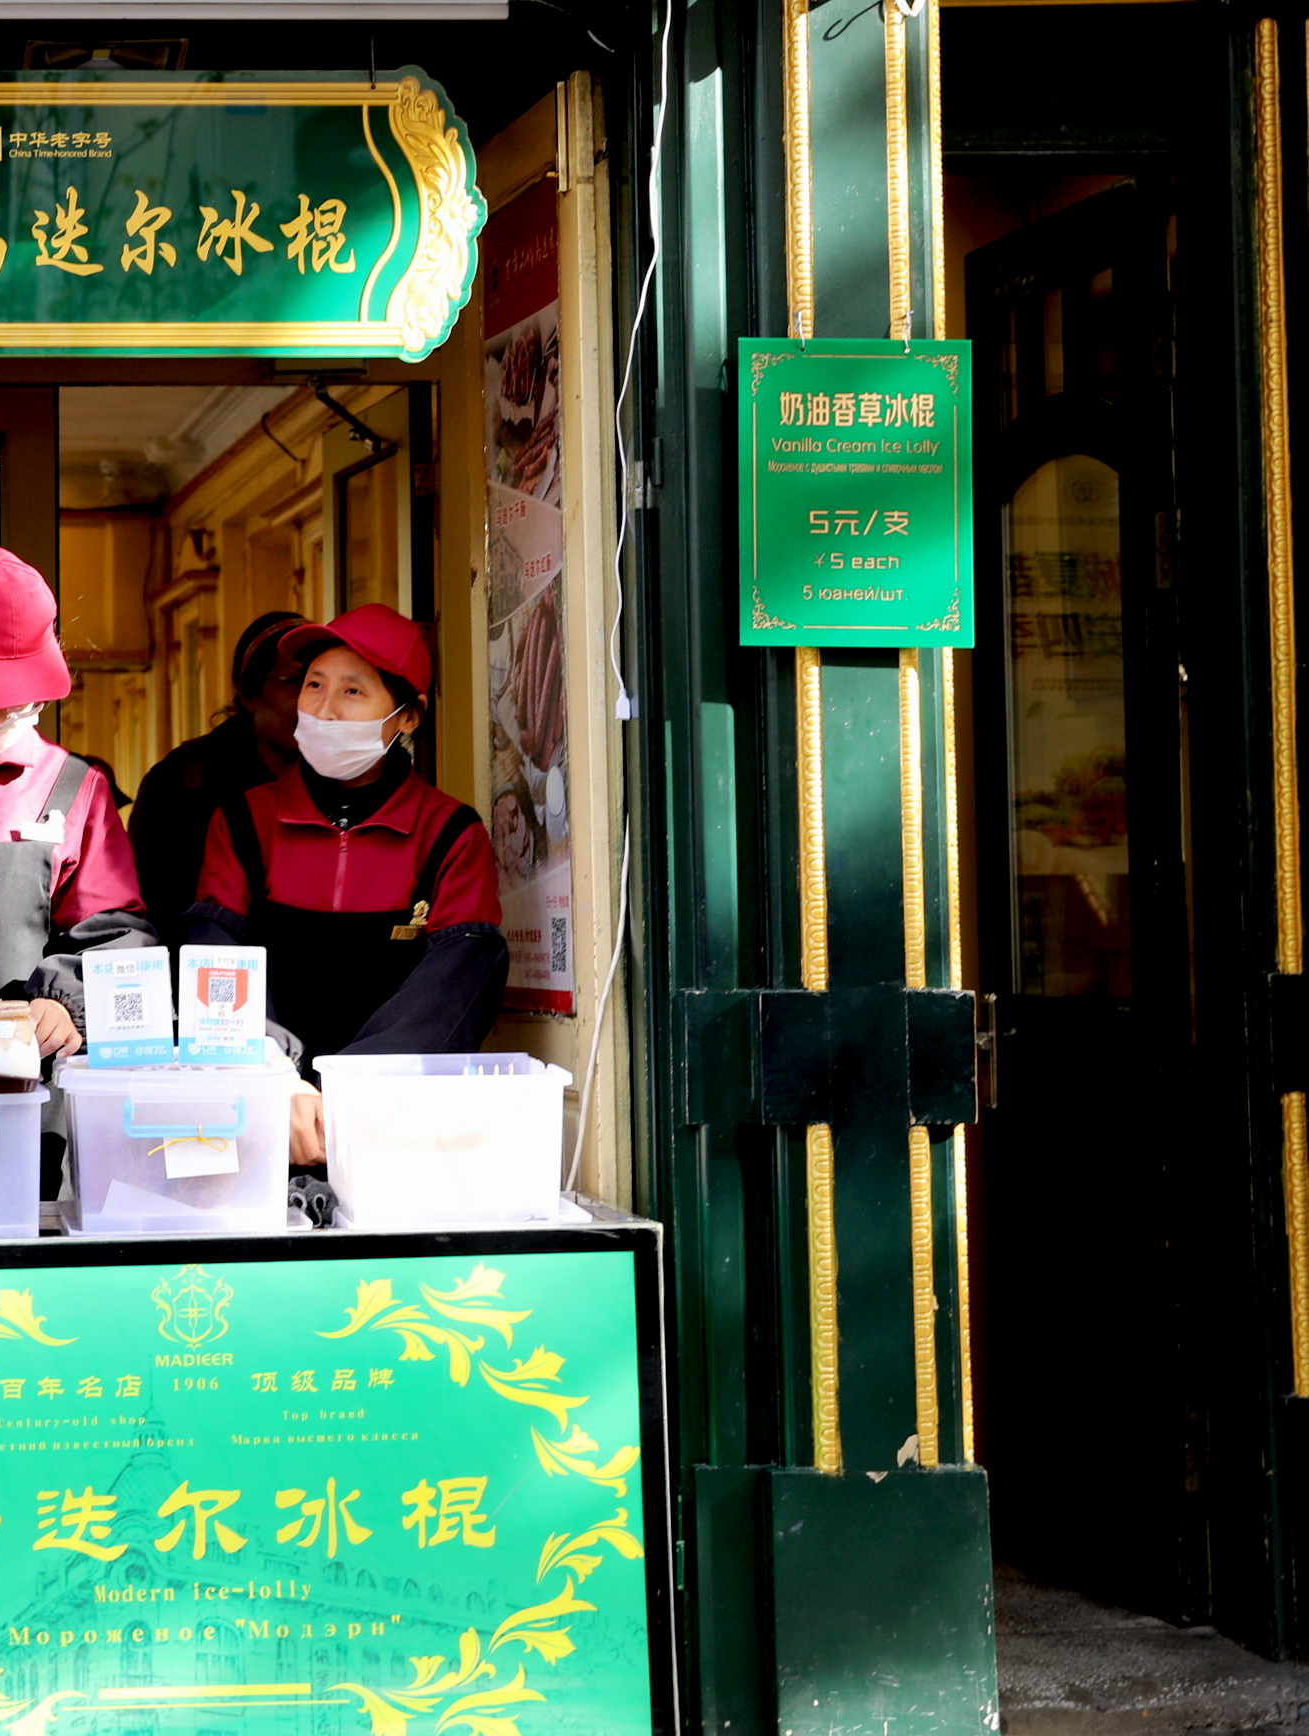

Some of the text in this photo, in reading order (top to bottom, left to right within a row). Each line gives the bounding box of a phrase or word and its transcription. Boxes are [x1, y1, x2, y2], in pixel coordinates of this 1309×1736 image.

[8, 131, 113, 149] 中华老字号
[8, 149, 112, 158] China Time-honored Brand
[779, 391, 935, 428] 奶油香草冰棍
[771, 437, 940, 457] Vanilla Cream Ice Lolly
[809, 509, 909, 536] 5元/支
[851, 553, 900, 570] each
[802, 585, 813, 601] 5
[155, 1353, 234, 1368] MADIEER
[172, 1377, 219, 1391] 1906
[251, 1367, 396, 1393] 顶级品牌
[110, 1415, 146, 1428] shop
[282, 1408, 365, 1422] Top brand
[231, 1434, 280, 1446] Марка
[361, 1430, 419, 1442] класса
[94, 1580, 312, 1603] Modern ice-lolly
[8, 1614, 401, 1648] Мороженое "Модэрн"
